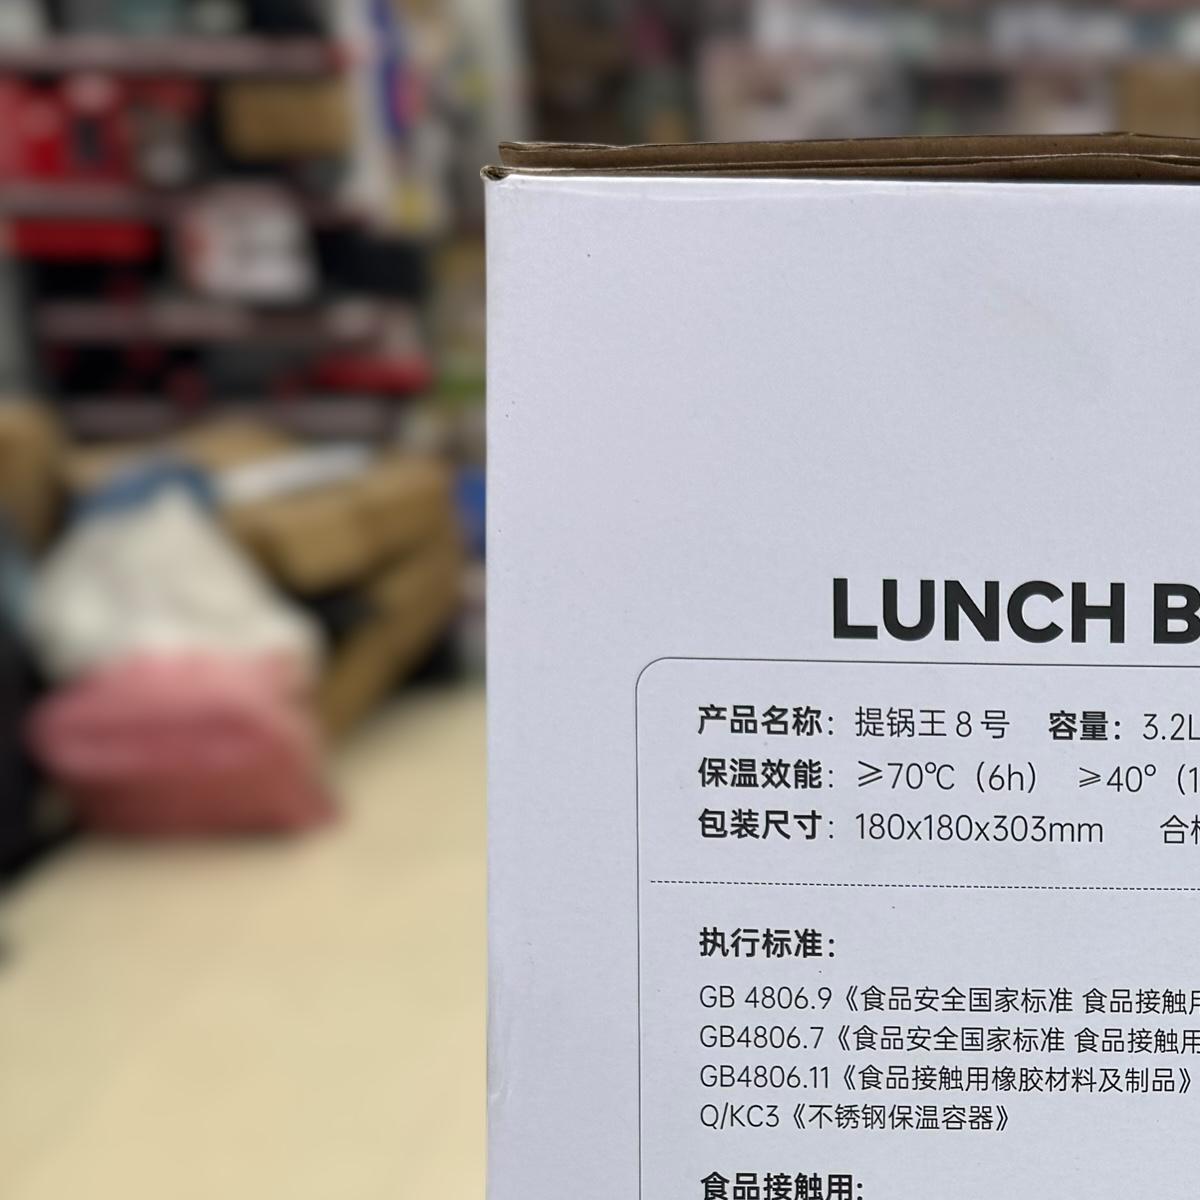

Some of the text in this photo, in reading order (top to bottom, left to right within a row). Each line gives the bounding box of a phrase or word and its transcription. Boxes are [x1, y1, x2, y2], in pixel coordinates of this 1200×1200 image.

[832, 577, 1126, 644] LUNCH
[855, 812, 1104, 843] 180x180x303mm
[699, 984, 736, 1009] GB
